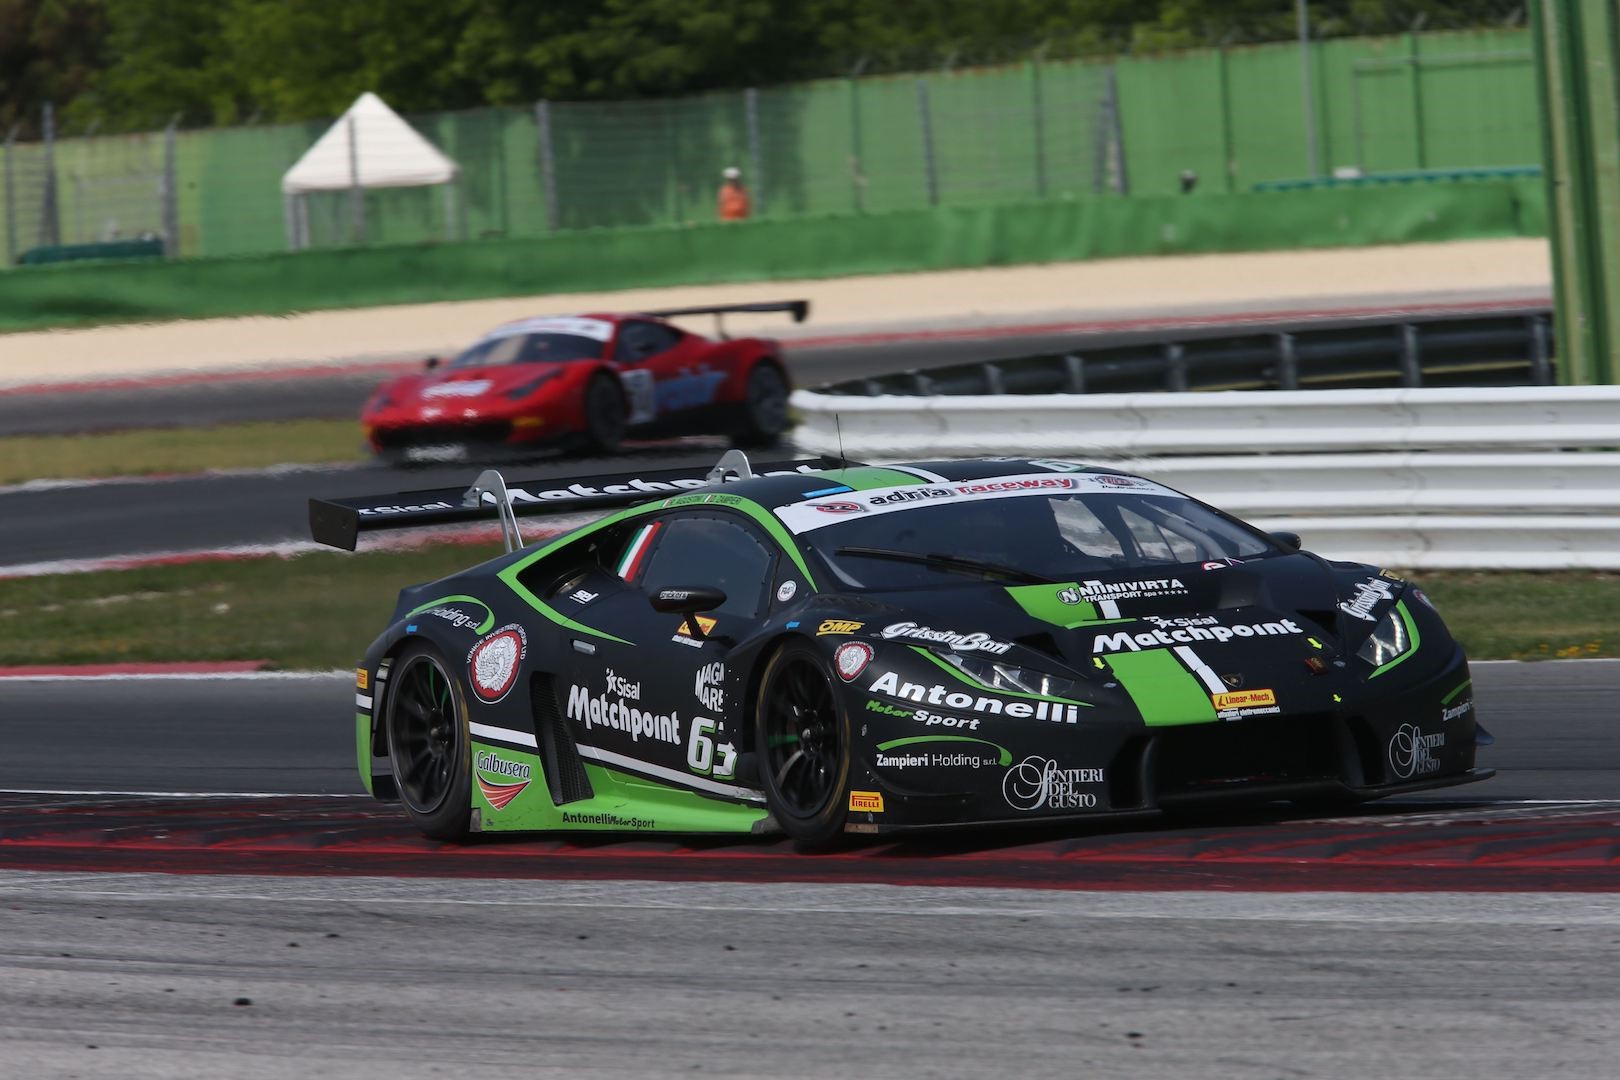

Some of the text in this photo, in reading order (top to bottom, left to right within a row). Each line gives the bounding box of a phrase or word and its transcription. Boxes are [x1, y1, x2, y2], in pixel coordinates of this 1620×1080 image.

[869, 488, 950, 505] adria
[957, 477, 1072, 494] raceway
[374, 501, 453, 513] Sisal
[1083, 590, 1142, 603] TRANSPORT
[817, 620, 864, 634] OMP
[1176, 616, 1219, 628] Sisal
[1093, 619, 1304, 653] Matchpoint
[617, 676, 641, 700] Sisal
[868, 671, 1078, 724] Antonelli
[567, 684, 681, 746] Matchpoint
[476, 751, 531, 779] Galbusera
[876, 753, 929, 769] Zampieri
[932, 753, 980, 769] Holding
[1047, 783, 1079, 796] DEL
[851, 795, 880, 808] PIRELLI
[1047, 793, 1097, 809] GUSTO
